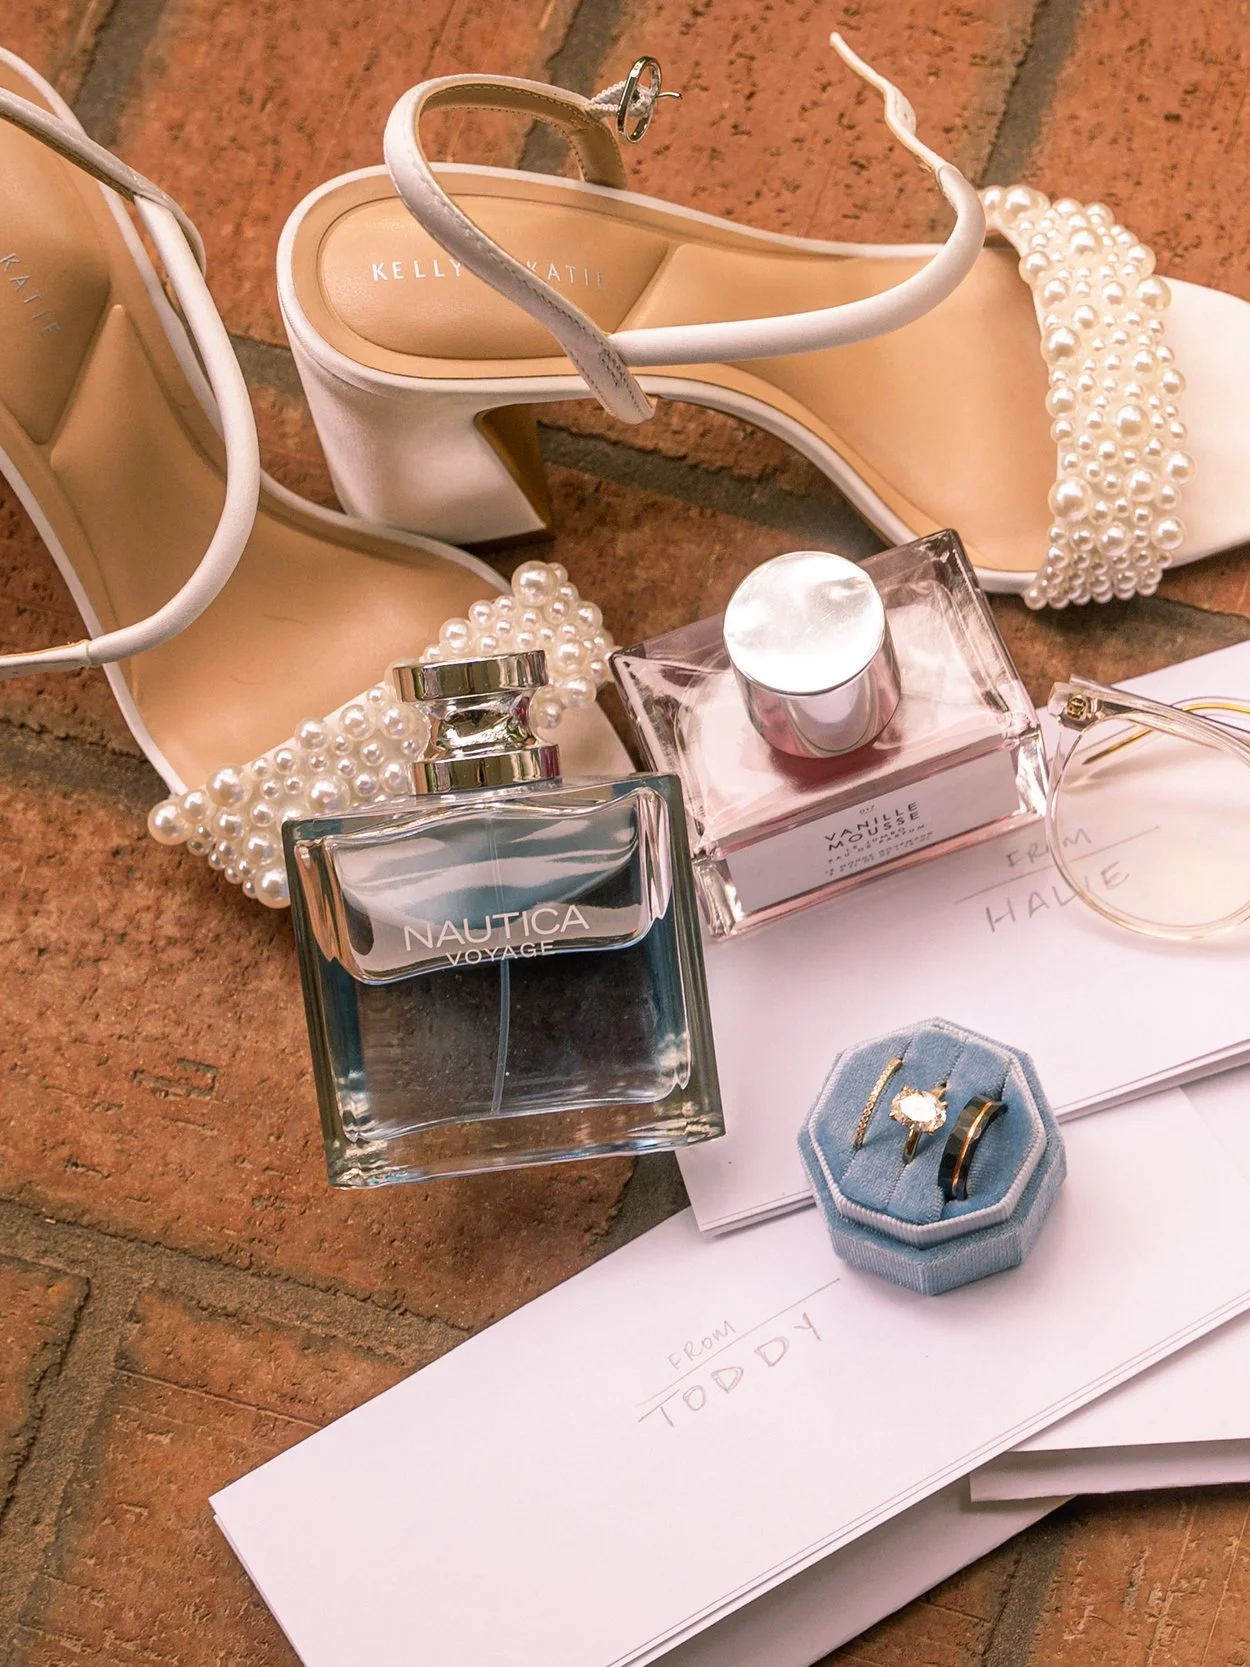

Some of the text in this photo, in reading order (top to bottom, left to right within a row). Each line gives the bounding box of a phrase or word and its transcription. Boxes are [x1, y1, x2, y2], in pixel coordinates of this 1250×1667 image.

[371, 258, 463, 282] KELLY
[824, 801, 919, 842] VANILLE
[827, 811, 921, 852] MOUSSE
[878, 823, 926, 845] PARFUM
[403, 903, 591, 952] NAUTICA
[446, 939, 557, 967] VOYAGE
[666, 1319, 738, 1370] FROM
[638, 1311, 823, 1428] TODDY
